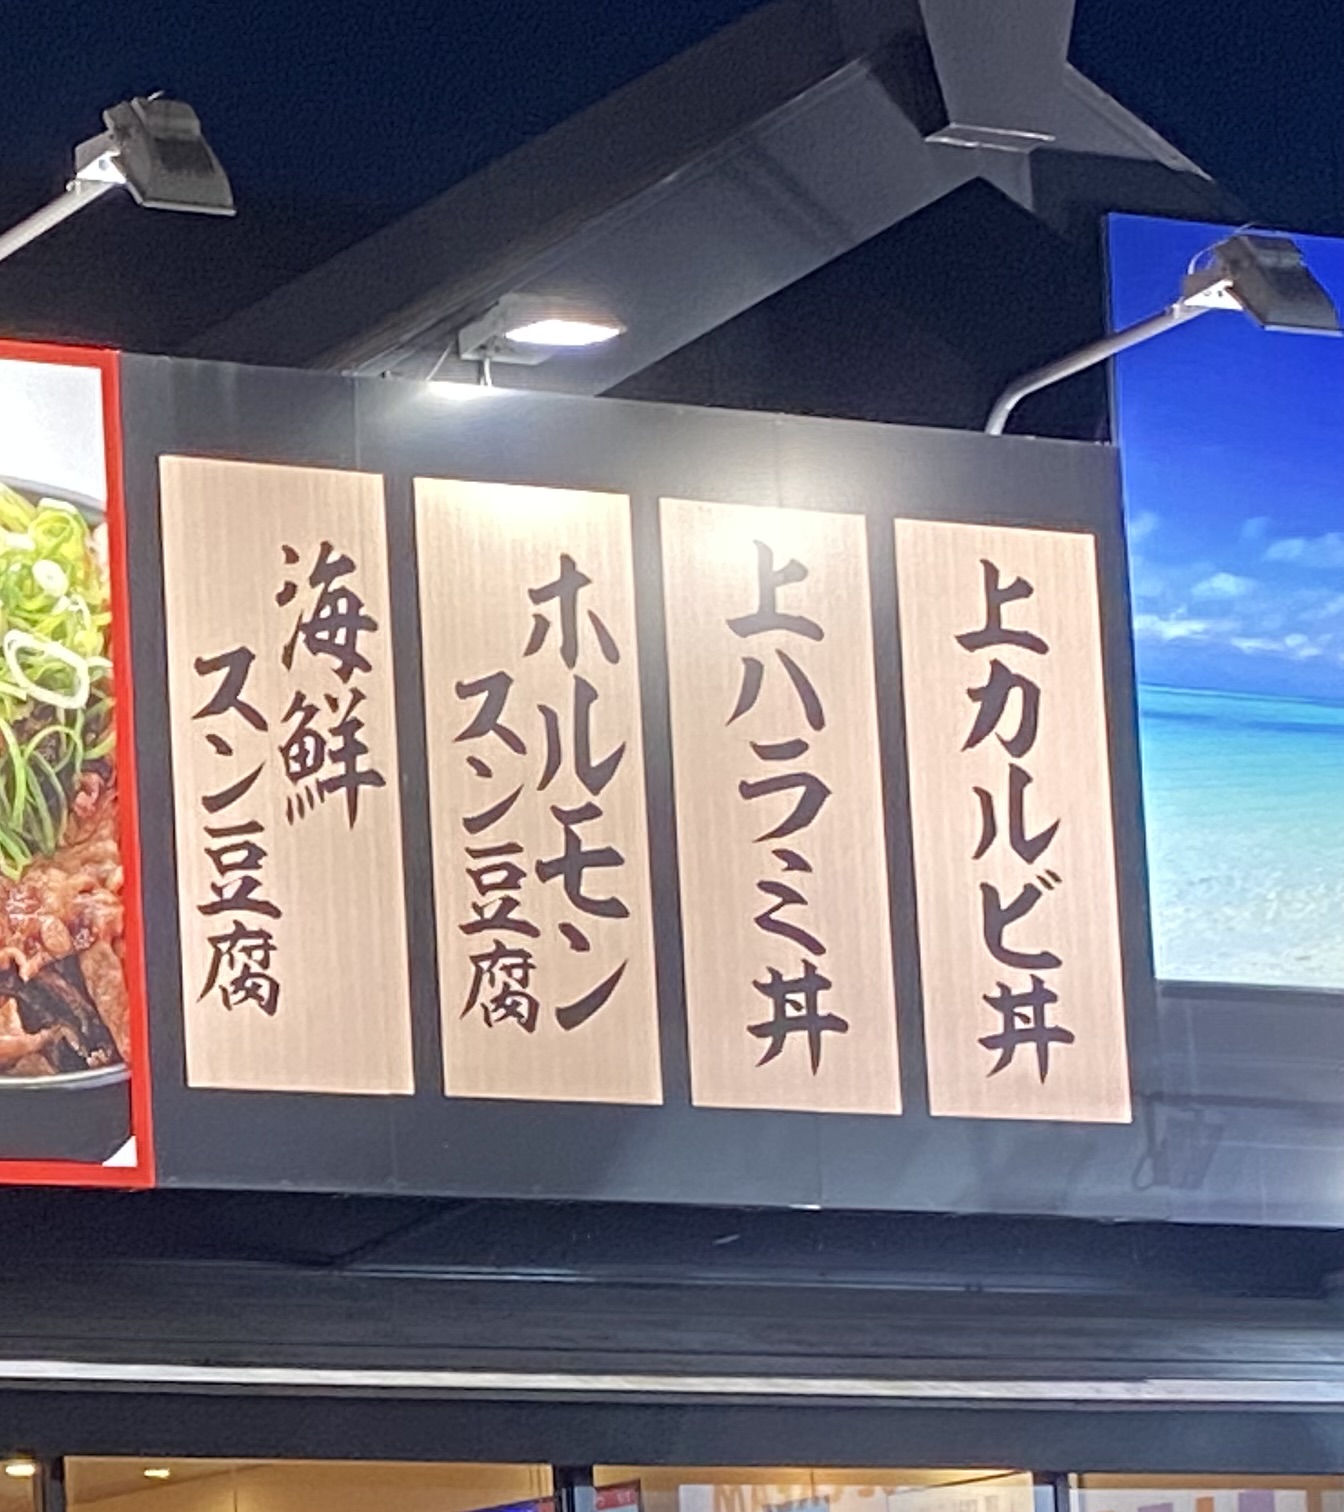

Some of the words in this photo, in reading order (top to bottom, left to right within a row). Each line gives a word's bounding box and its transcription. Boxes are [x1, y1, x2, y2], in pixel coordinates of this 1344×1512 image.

[191, 645, 282, 1017] スン豆腐
[276, 540, 386, 829] 海鮮
[454, 671, 539, 1035] スン豆腐
[523, 552, 632, 1032] ホルモン
[726, 540, 849, 1076] 上ハラミ丼
[955, 558, 1075, 1085] 上カルビ丼
